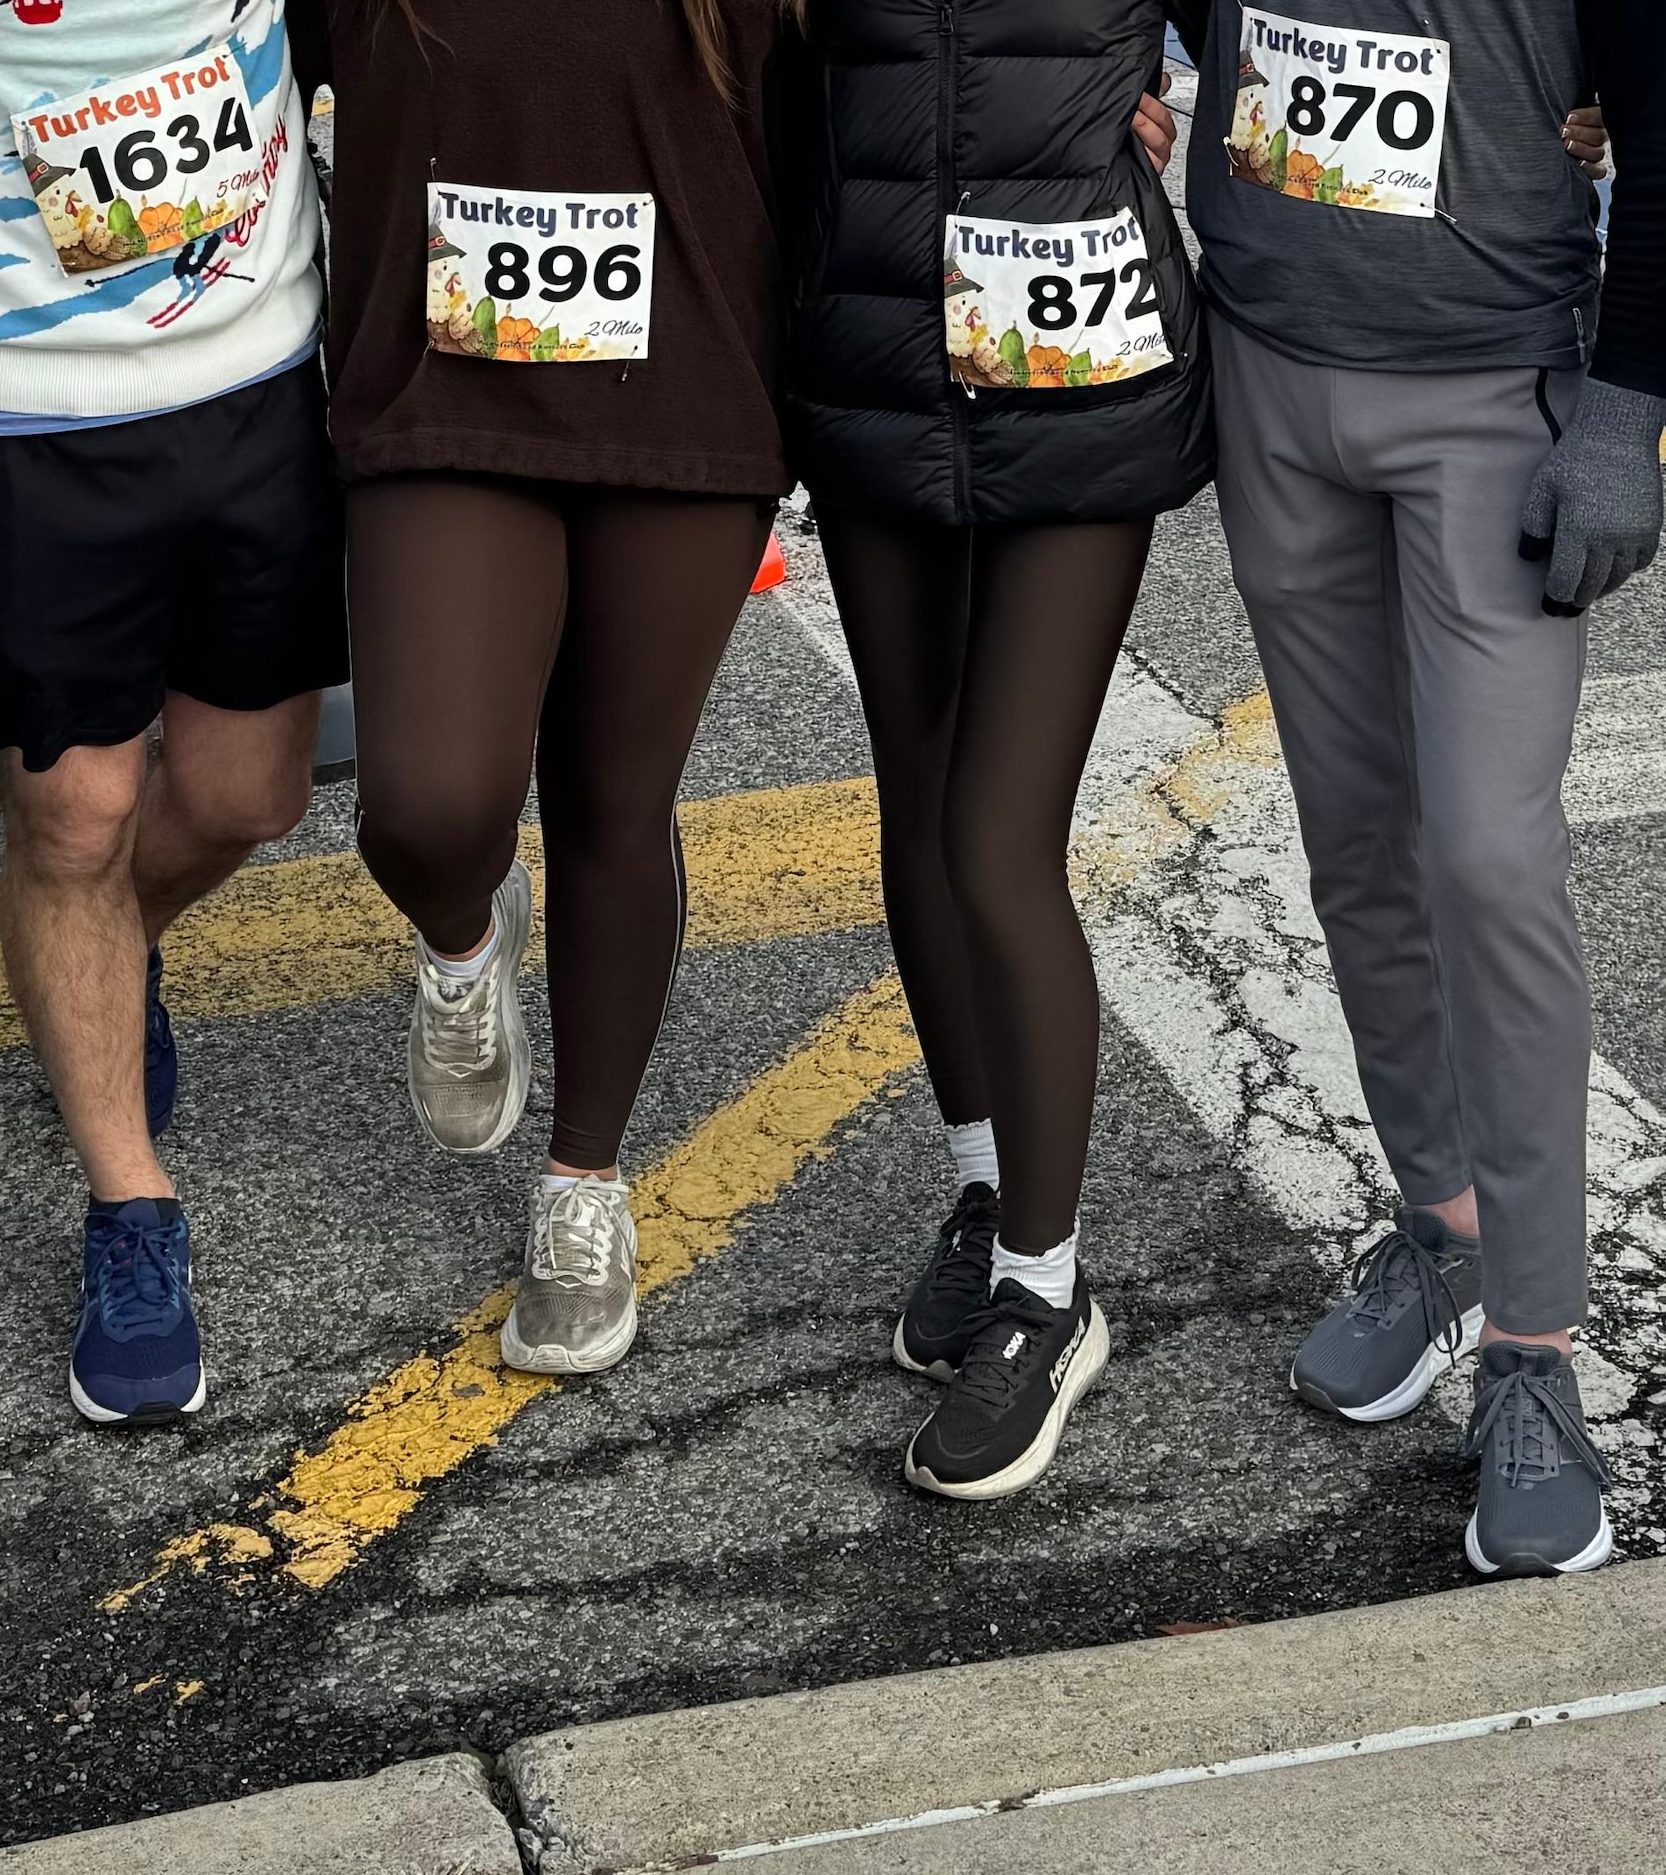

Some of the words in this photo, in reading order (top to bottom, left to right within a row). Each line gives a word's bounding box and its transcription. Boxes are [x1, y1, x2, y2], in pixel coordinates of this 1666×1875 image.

[1253, 19, 1347, 74] Turkey
[1356, 40, 1434, 75] Trot
[29, 85, 161, 143] Turkey
[161, 56, 231, 100] Trot
[1286, 75, 1434, 150] 870
[79, 97, 253, 204] 1634
[217, 180, 229, 198] 5
[1369, 169, 1386, 185] 2
[1388, 170, 1432, 190] Mile
[441, 191, 557, 238] Turkey
[565, 202, 639, 230] Trot
[959, 225, 1074, 267] Turkey
[1081, 219, 1139, 257] Trot
[485, 241, 641, 303] 896
[1027, 258, 1160, 331] 872
[584, 322, 599, 337] 2
[602, 319, 644, 337] Mile
[1116, 342, 1131, 356] 2
